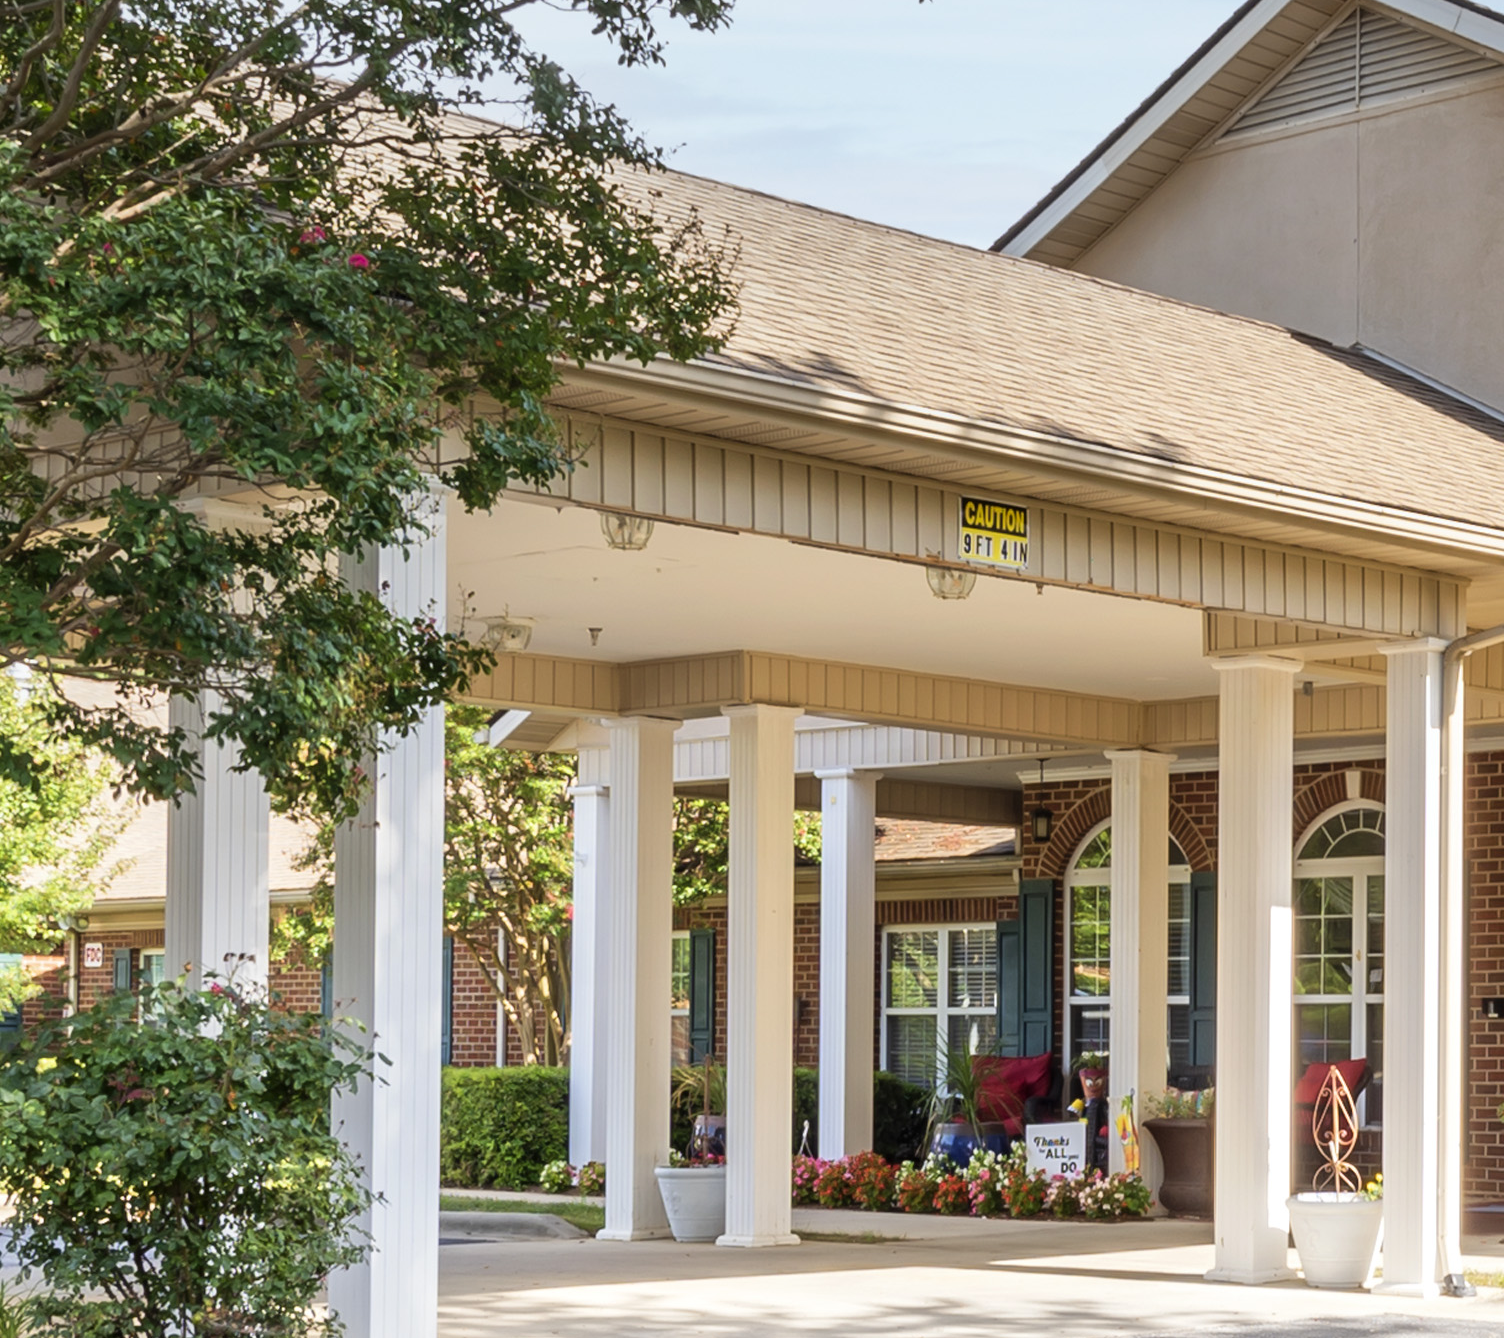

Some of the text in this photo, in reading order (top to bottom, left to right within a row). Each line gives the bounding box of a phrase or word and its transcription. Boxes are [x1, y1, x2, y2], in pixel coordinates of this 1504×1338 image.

[965, 501, 1024, 534] CAUTION
[964, 533, 1027, 563] 9 FT 4 IN
[1046, 1147, 1067, 1159] ALL
[1061, 1162, 1077, 1173] DO
